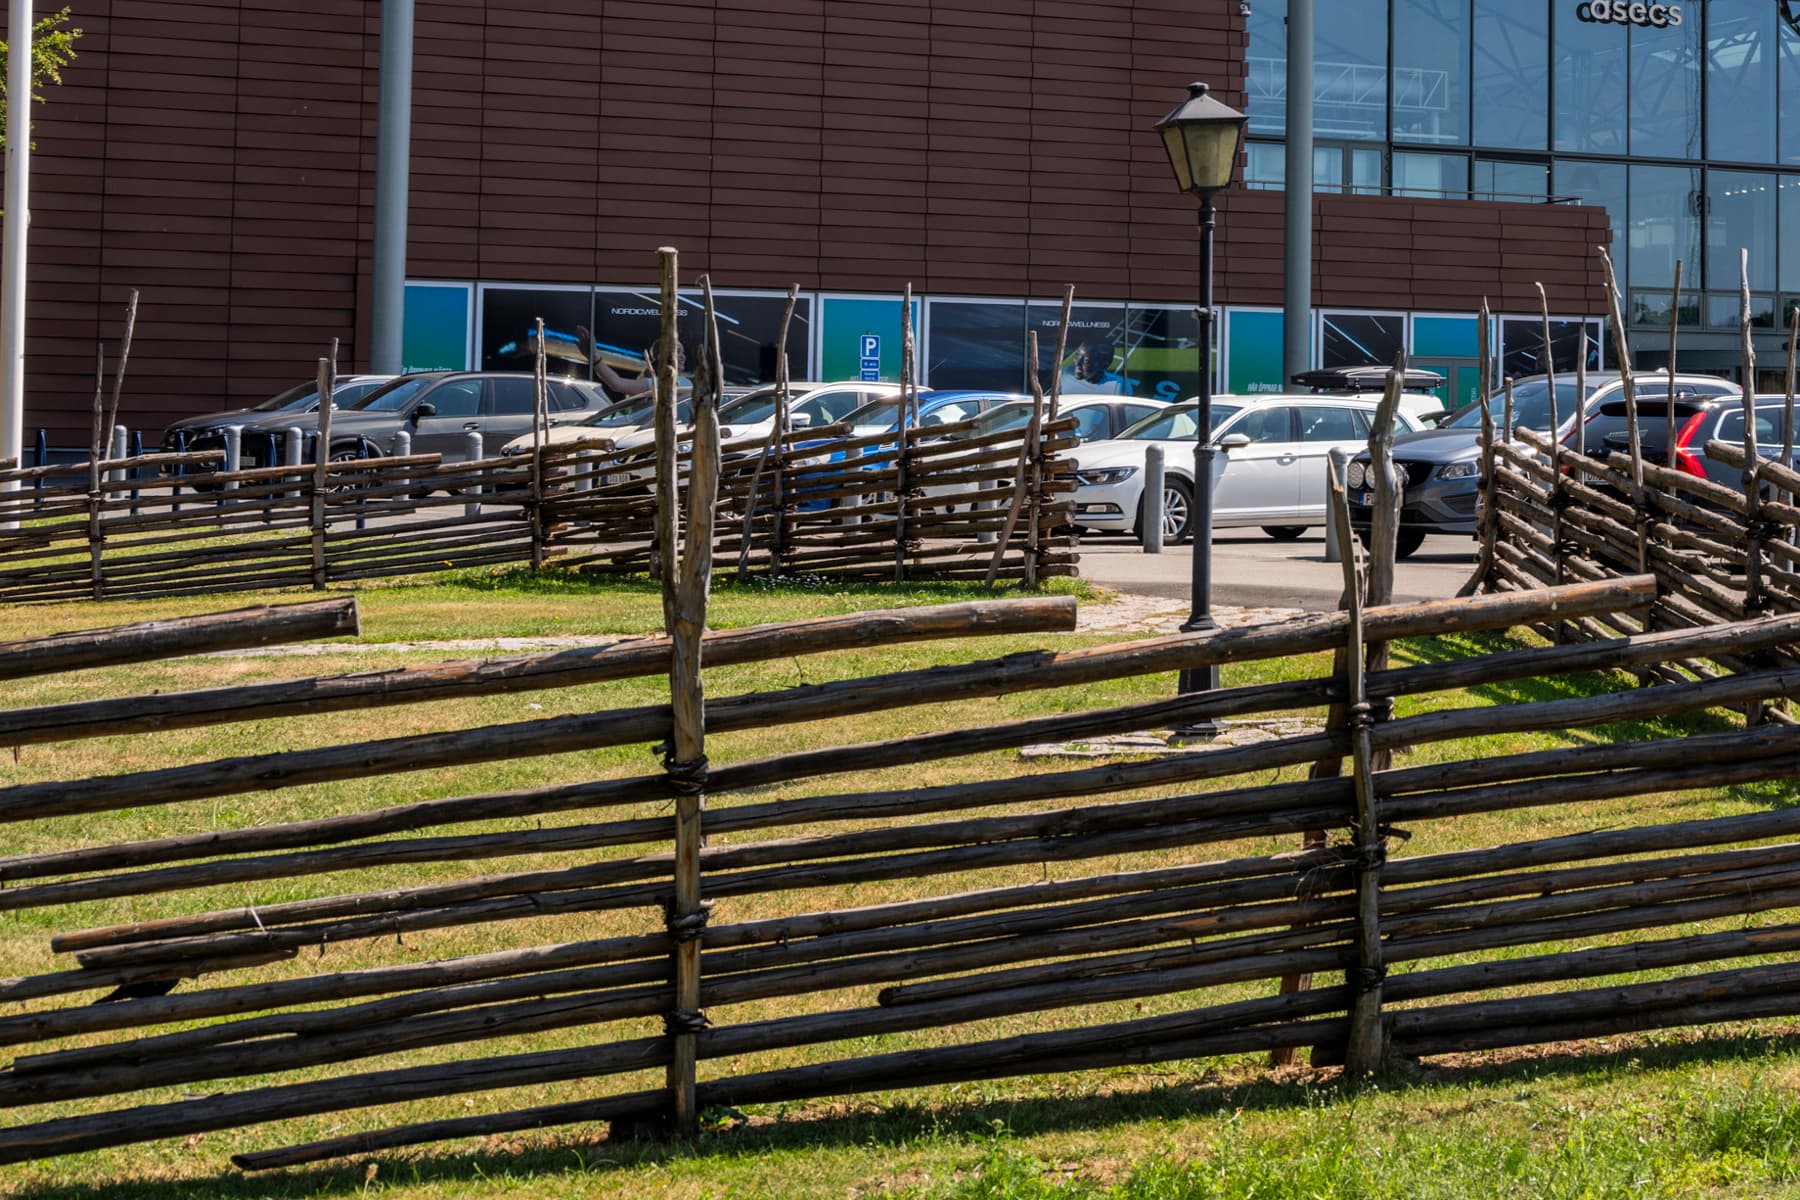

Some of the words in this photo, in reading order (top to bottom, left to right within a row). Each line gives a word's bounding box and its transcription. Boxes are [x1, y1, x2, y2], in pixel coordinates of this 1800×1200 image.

[1590, 0, 1682, 26] asecs
[611, 308, 688, 317] NORDICWELSS
[1042, 320, 1111, 329] NORCWELLNESS
[865, 338, 877, 356] P
